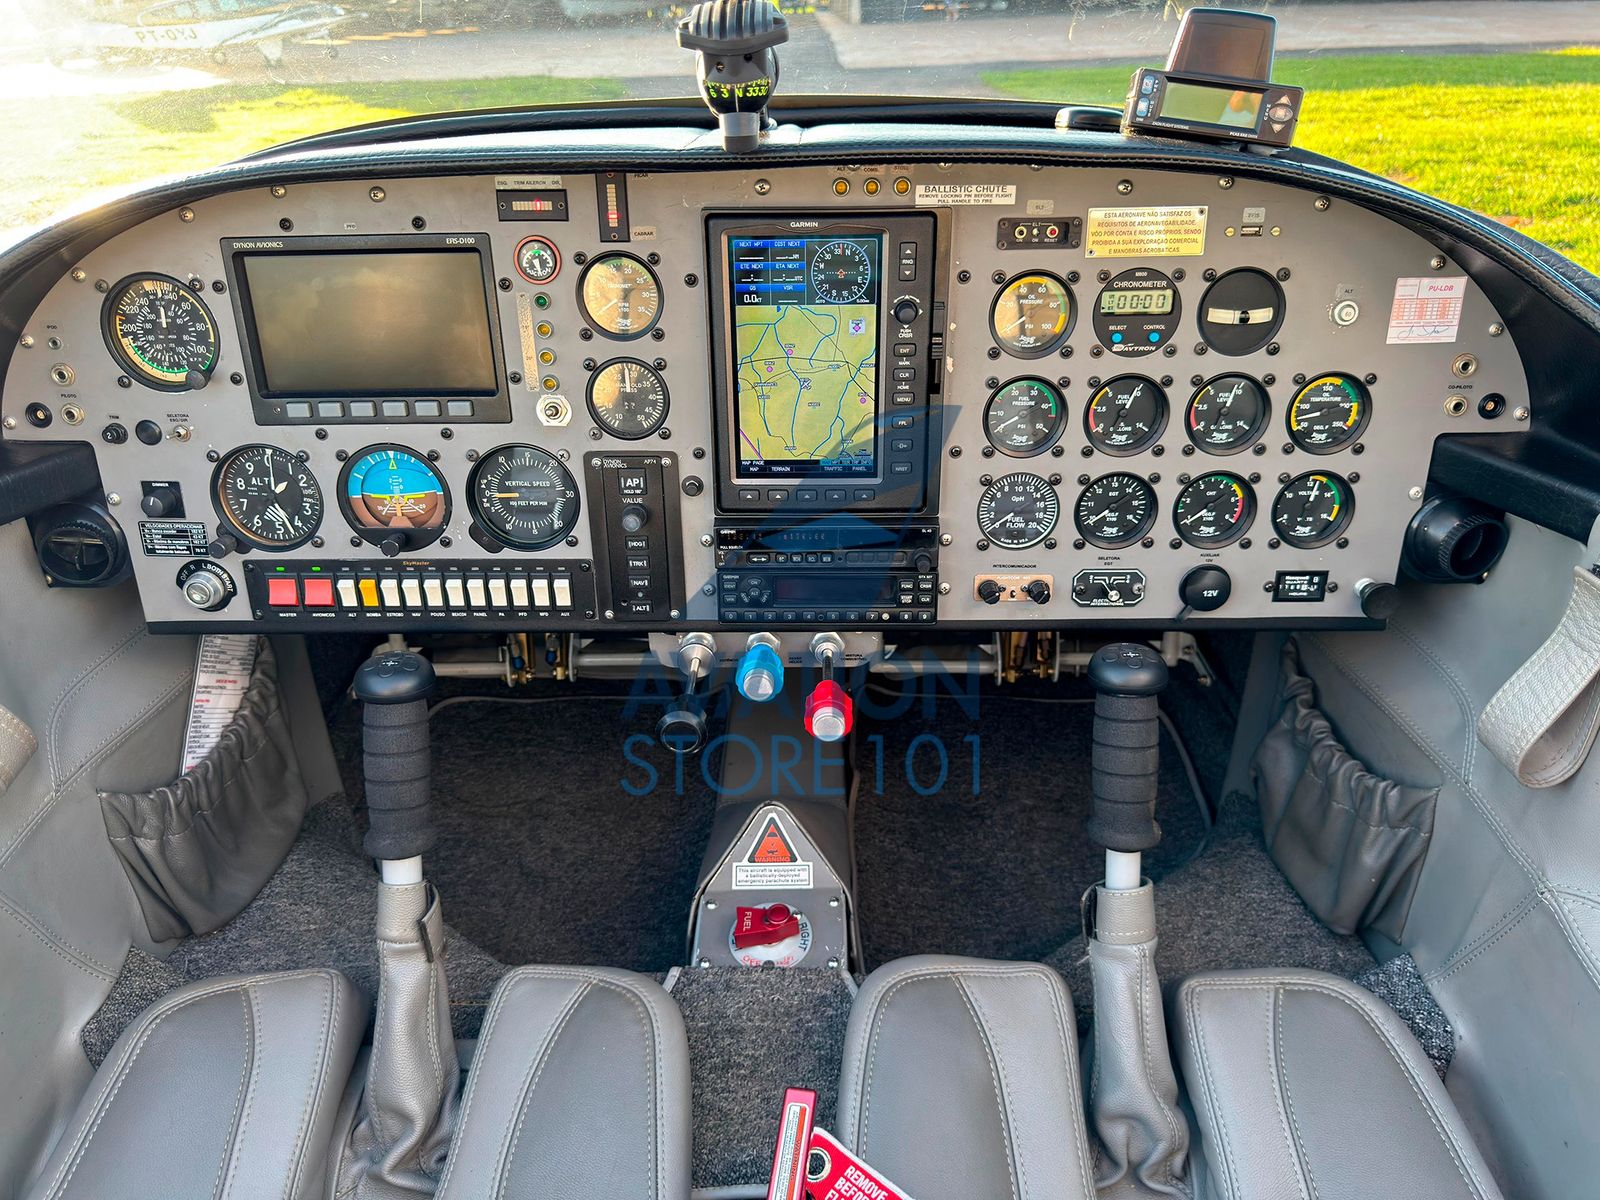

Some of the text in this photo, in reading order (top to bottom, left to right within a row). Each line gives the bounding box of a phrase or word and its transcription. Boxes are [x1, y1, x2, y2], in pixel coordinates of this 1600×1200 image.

[924, 185, 1008, 193] BALLISTIC CHUTE
[446, 237, 475, 245] EFIS-D100
[1113, 280, 1167, 288] CHRONOMETER
[135, 297, 149, 307] 240
[181, 302, 192, 311] 60
[126, 305, 140, 314] 220
[123, 324, 138, 333] 200
[196, 323, 206, 331] 80
[245, 462, 255, 475] 9
[236, 477, 246, 491] 8
[251, 477, 270, 486] ALT
[298, 474, 307, 487] 2
[625, 478, 640, 488] AP
[239, 498, 248, 511] 7
[302, 502, 312, 516] 3
[253, 514, 262, 527] 6
[294, 515, 302, 528] 4
[275, 521, 285, 534] 5
[180, 570, 189, 581] OFF
[207, 563, 223, 576] BOTH
[221, 572, 234, 593] START
[743, 911, 752, 931] FUEL
[799, 922, 811, 952] RIGHT
[844, 1165, 889, 1200] REMOVE
